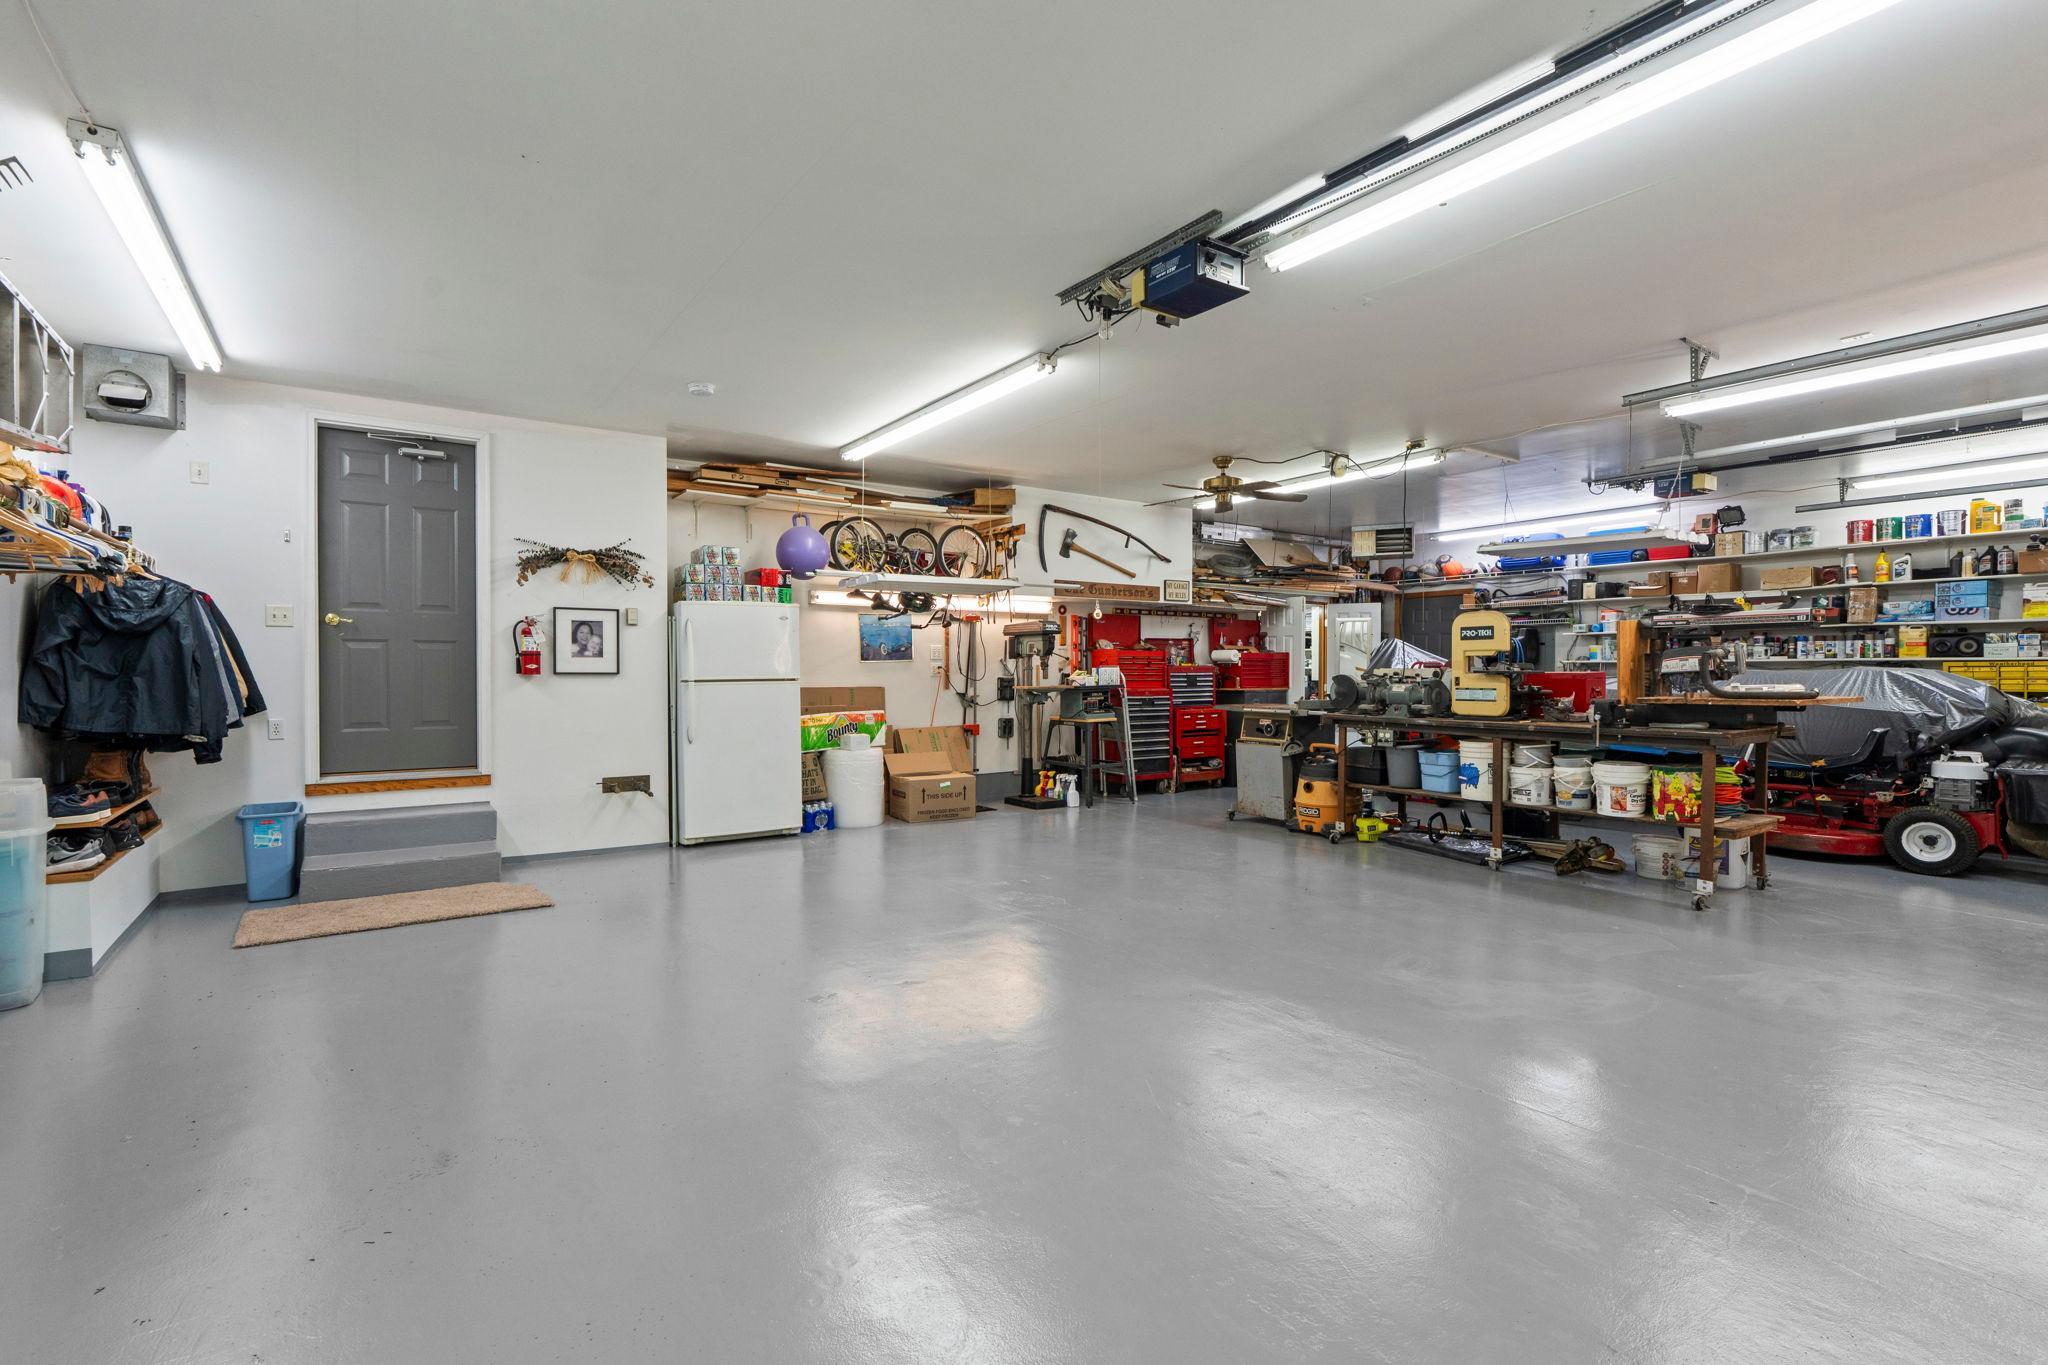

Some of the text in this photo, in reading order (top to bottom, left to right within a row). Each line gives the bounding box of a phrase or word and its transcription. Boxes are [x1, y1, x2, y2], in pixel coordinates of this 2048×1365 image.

[1088, 584, 1154, 598] Gunderson's
[1461, 629, 1492, 637] PRO-TECH
[827, 722, 858, 743] Bounty
[802, 769, 819, 778] HAT'S
